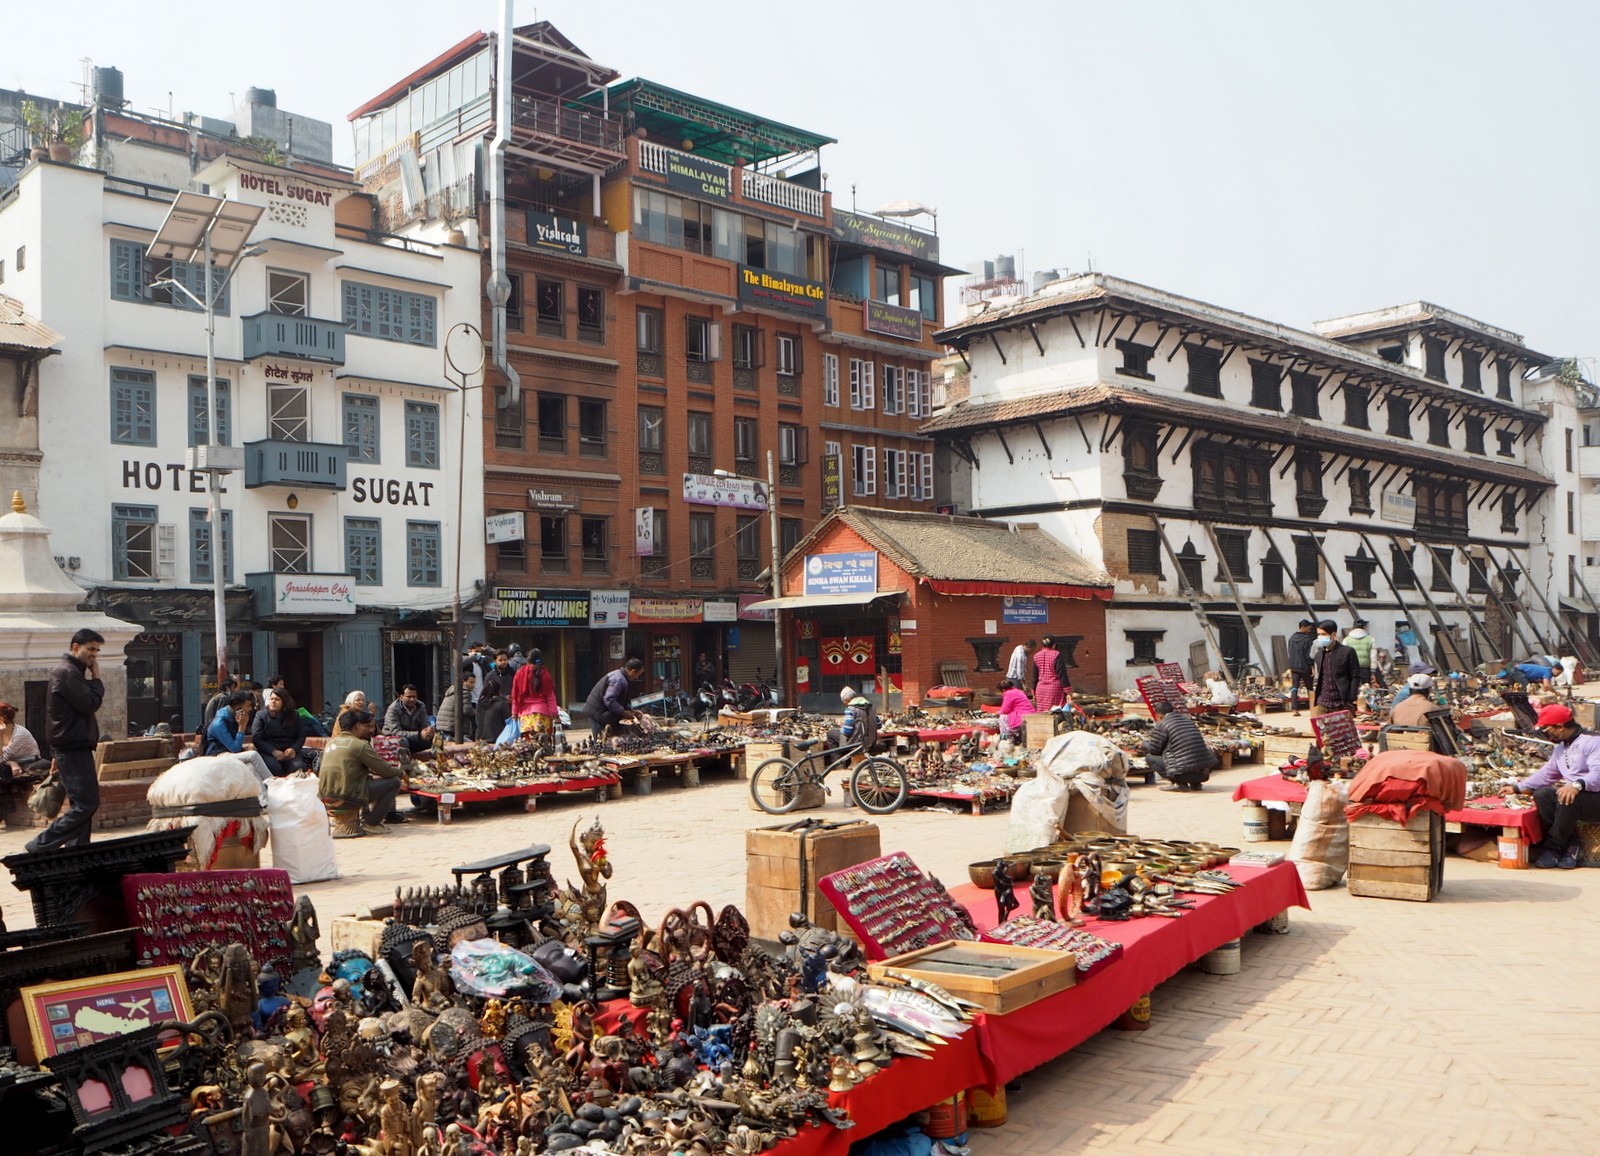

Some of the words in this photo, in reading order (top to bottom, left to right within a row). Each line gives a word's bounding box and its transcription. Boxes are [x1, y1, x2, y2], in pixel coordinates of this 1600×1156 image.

[669, 155, 680, 163] THE
[669, 162, 726, 187] HIMALAYAN
[240, 173, 284, 197] HOTEL
[286, 184, 332, 207] SUGAT
[701, 183, 727, 198] CAFE
[535, 216, 581, 245] Vishram
[864, 223, 902, 241] Square
[903, 233, 926, 249] Cafe
[743, 269, 760, 285] The
[761, 274, 805, 296] Himalayan
[805, 284, 824, 300] Cafe
[695, 476, 716, 488] UNIQUE
[352, 477, 434, 507] SUGAT
[529, 489, 562, 502] Vishram
[285, 581, 329, 596] Grasshopper
[331, 582, 349, 597] Cafe
[498, 589, 538, 599] BASANTAPUR
[601, 594, 629, 604] Vishram
[500, 600, 535, 619] MONEY
[535, 600, 588, 619] EXCHANGE
[96, 997, 117, 1007] NEPAL
